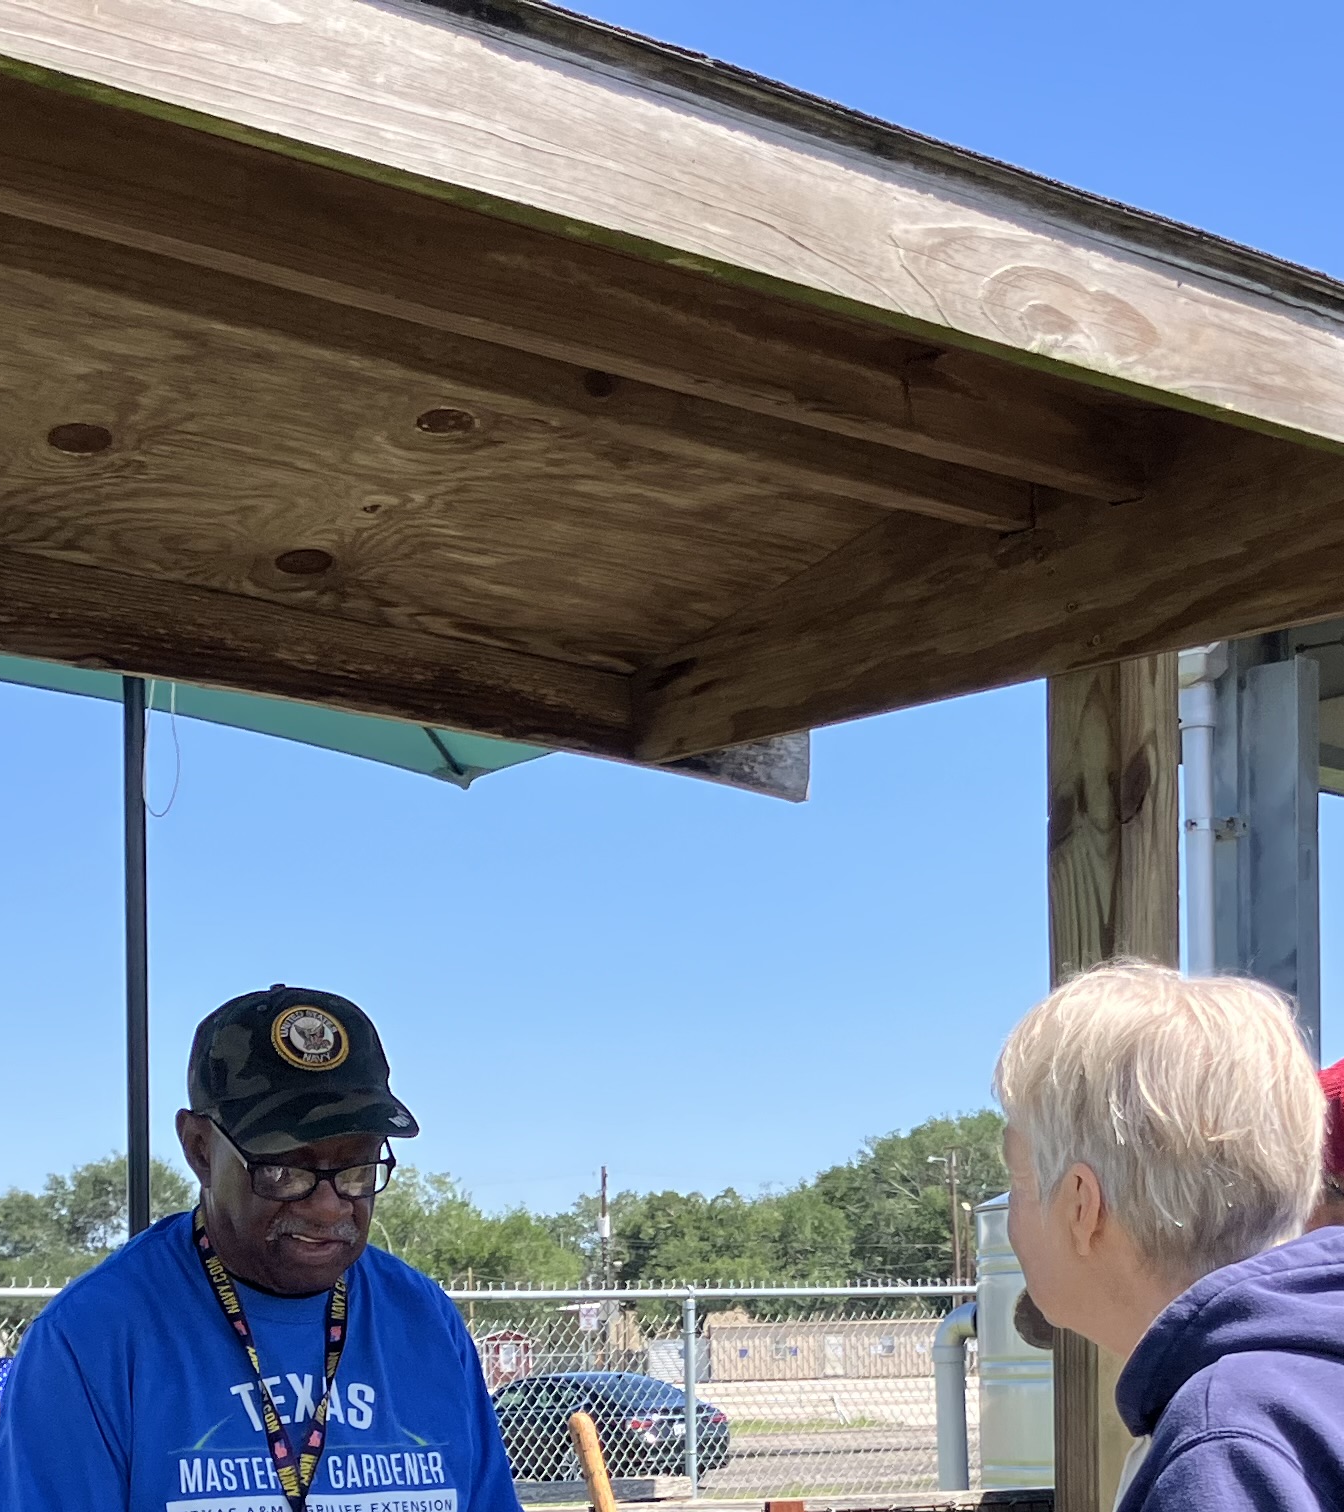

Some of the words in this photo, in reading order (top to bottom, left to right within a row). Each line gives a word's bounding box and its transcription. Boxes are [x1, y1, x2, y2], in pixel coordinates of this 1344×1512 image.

[280, 1011, 304, 1038] UNITED
[306, 1011, 338, 1033] STATES
[302, 1052, 331, 1063] NAVY
[205, 1255, 241, 1315] NAVY.COM
[229, 1373, 376, 1433] TEXAS
[328, 1450, 446, 1489] GARDENER
